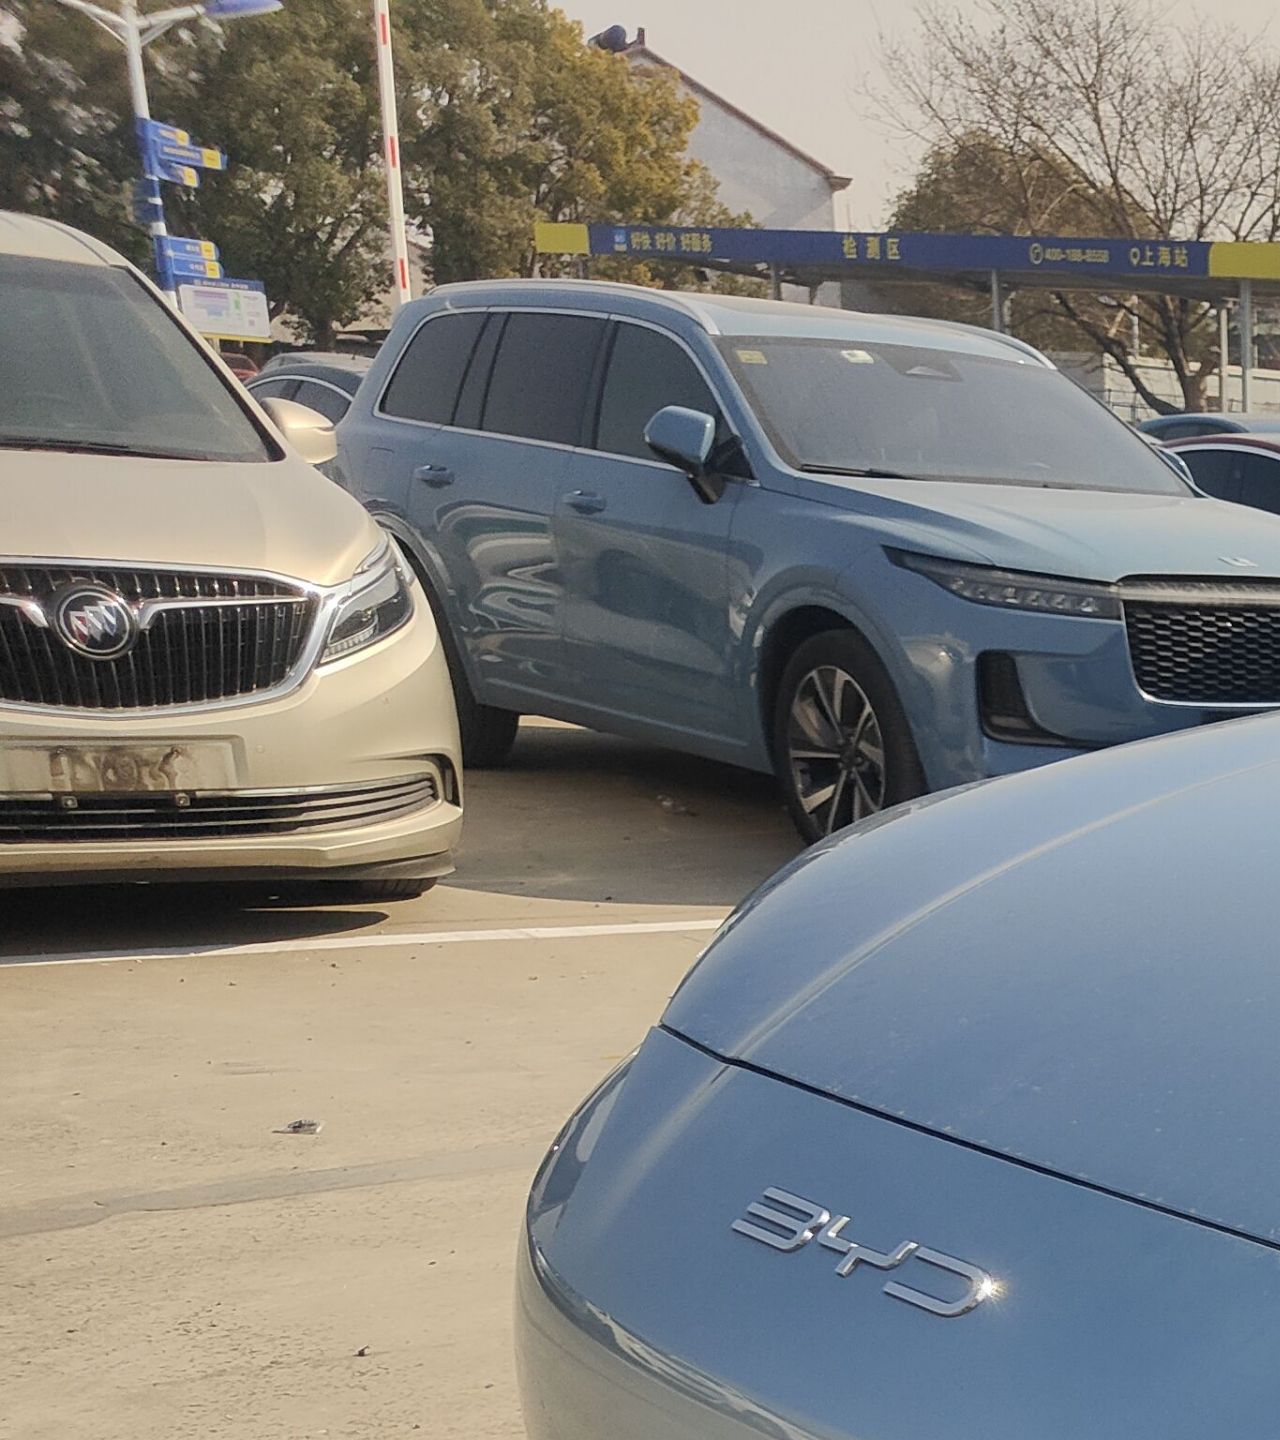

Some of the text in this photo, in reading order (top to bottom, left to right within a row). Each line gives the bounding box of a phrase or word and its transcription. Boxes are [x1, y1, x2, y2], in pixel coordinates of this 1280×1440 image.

[1140, 244, 1189, 268] 上海站
[731, 1185, 996, 1318] BYD
